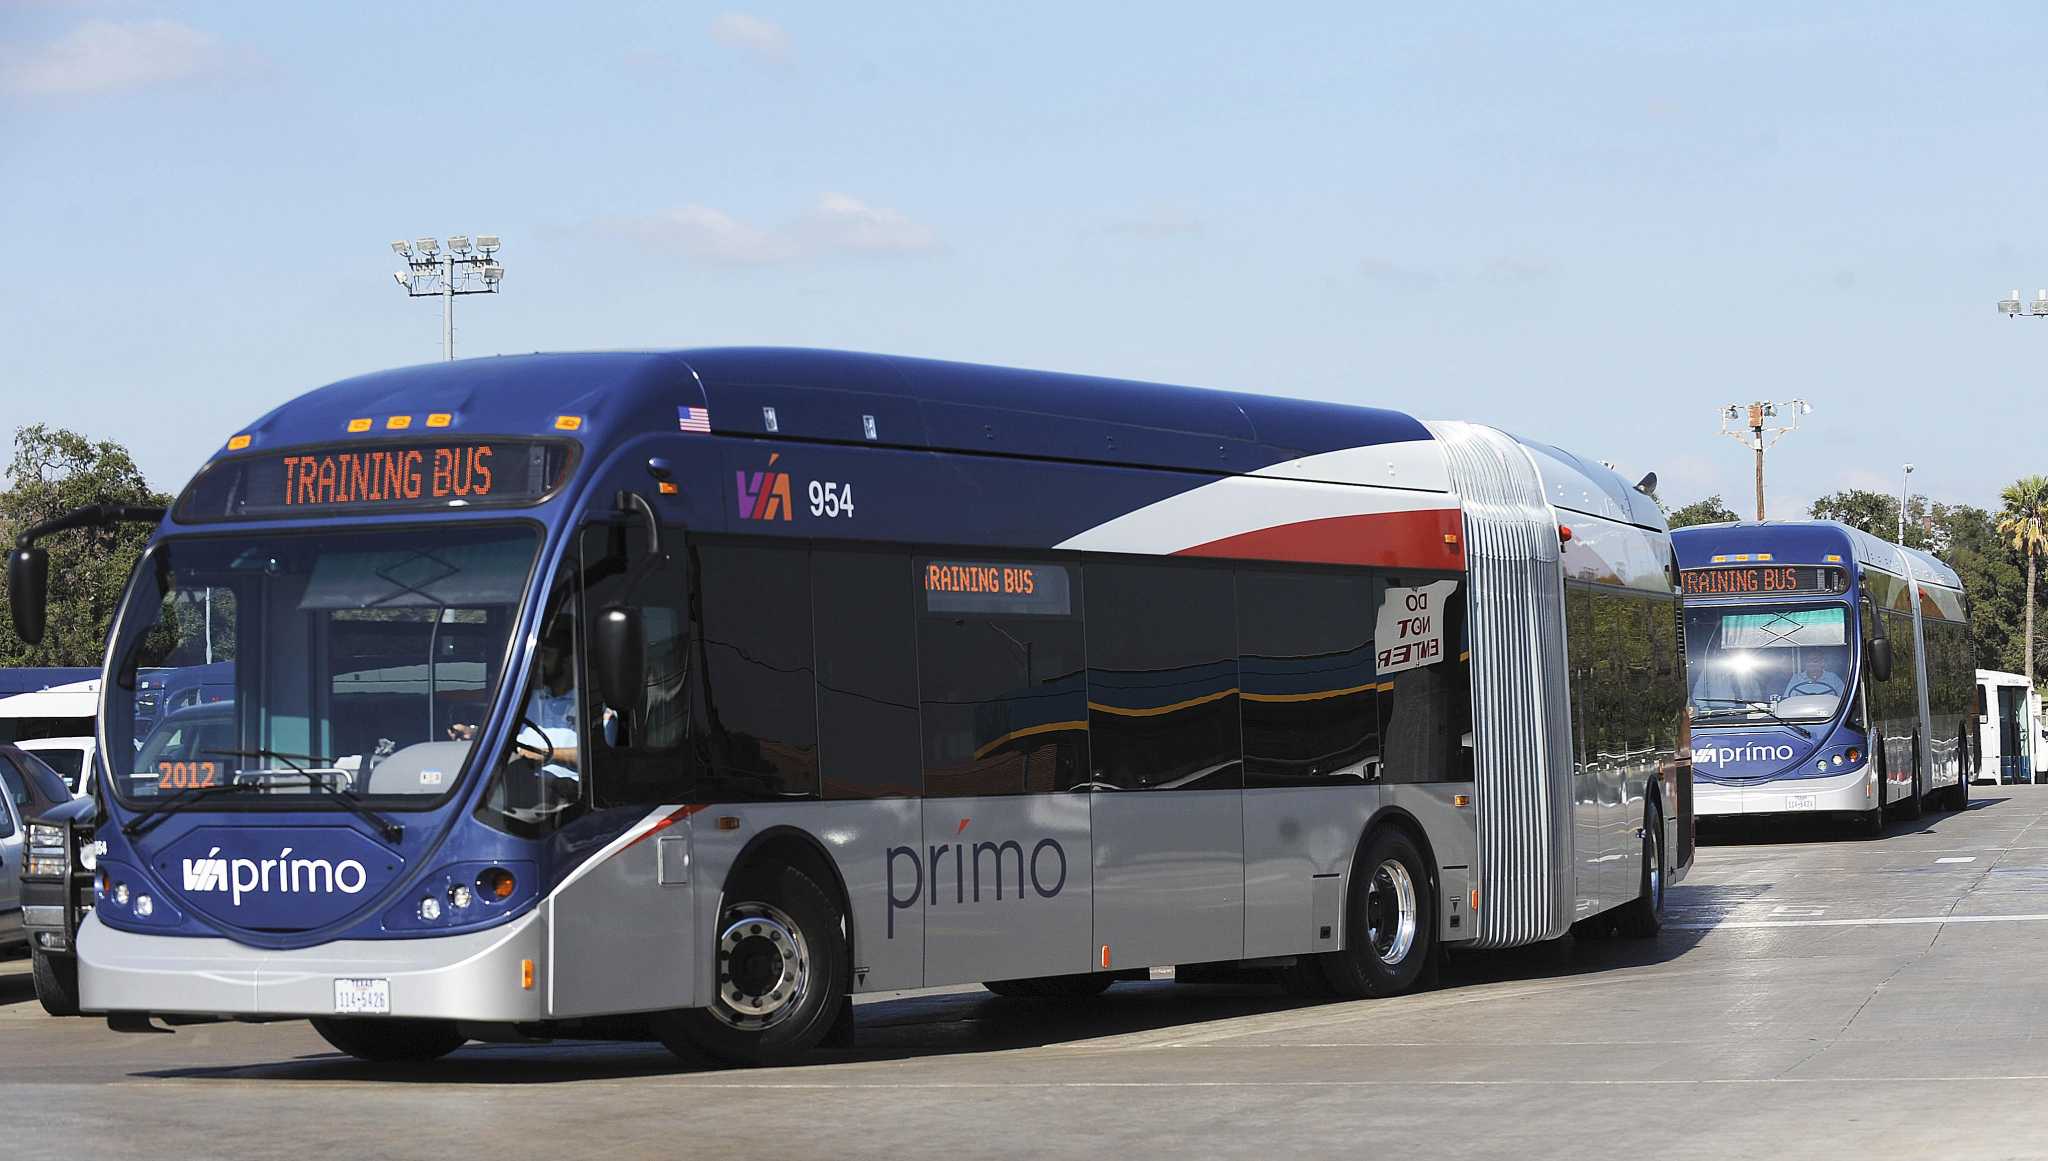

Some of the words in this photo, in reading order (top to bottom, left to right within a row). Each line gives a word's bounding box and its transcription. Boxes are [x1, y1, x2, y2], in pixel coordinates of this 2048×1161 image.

[283, 451, 423, 504] TRAINING
[432, 446, 493, 497] BUS
[808, 480, 854, 518] 954
[1004, 568, 1033, 593] BUS
[1680, 570, 1758, 593] TRAINING
[1764, 568, 1797, 591] BUS
[159, 761, 215, 788] 2012
